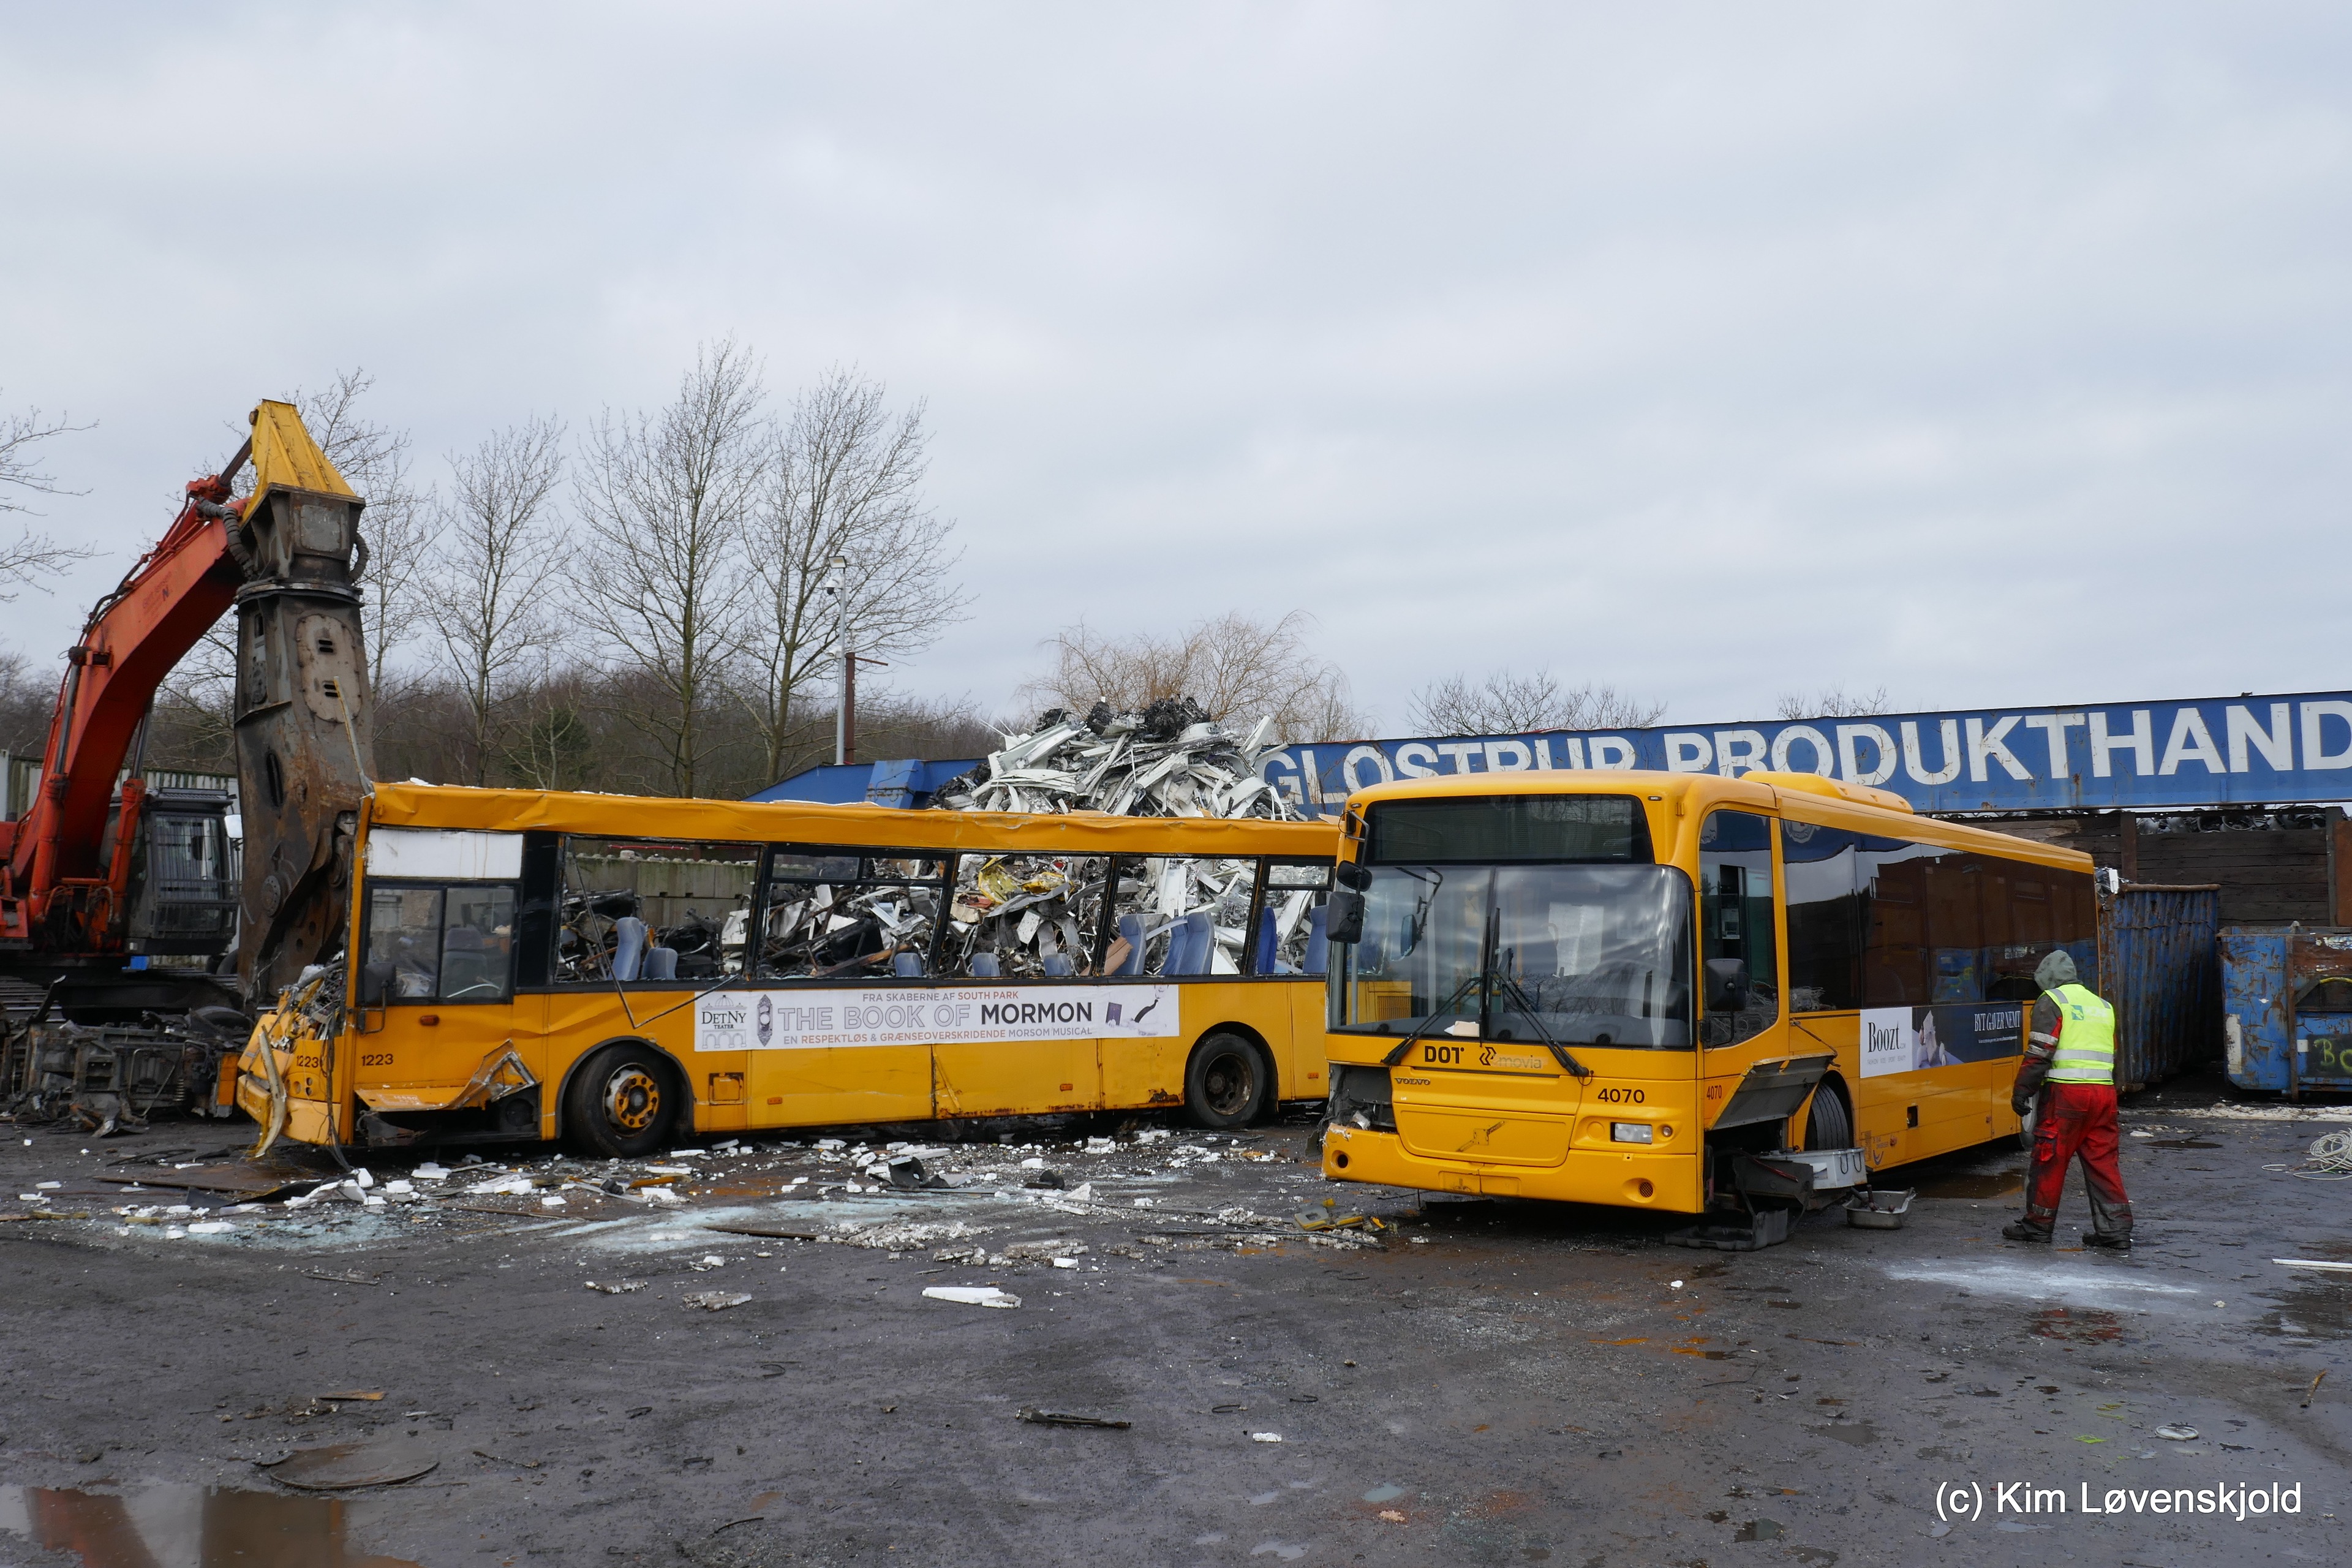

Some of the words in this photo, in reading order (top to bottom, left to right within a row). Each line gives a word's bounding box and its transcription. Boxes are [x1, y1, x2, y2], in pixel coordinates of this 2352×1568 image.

[862, 993, 883, 1002] FRA
[886, 992, 940, 1002] SKABERNE
[942, 992, 955, 1001] AF
[957, 992, 990, 1000] SOUTH
[993, 991, 1019, 1000] PARK
[777, 1006, 833, 1031] THE
[844, 1005, 925, 1030] BOOK
[933, 1004, 971, 1027] OF
[981, 1001, 1092, 1025] MORMON
[1974, 1013, 1986, 1032] BYT
[783, 1036, 798, 1044] EN
[801, 1033, 868, 1044] RESPEKTLØS
[880, 1029, 1006, 1041] GRÆNSEOVERSKRIDENDE
[1008, 1028, 1050, 1038] MORSOM
[1052, 1027, 1093, 1036] MUSICAL
[296, 1055, 319, 1068] 1223
[361, 1054, 394, 1066] 1223
[1499, 1055, 1542, 1069] movia
[1597, 1088, 1645, 1103] 4070
[1706, 1085, 1722, 1100] 4070
